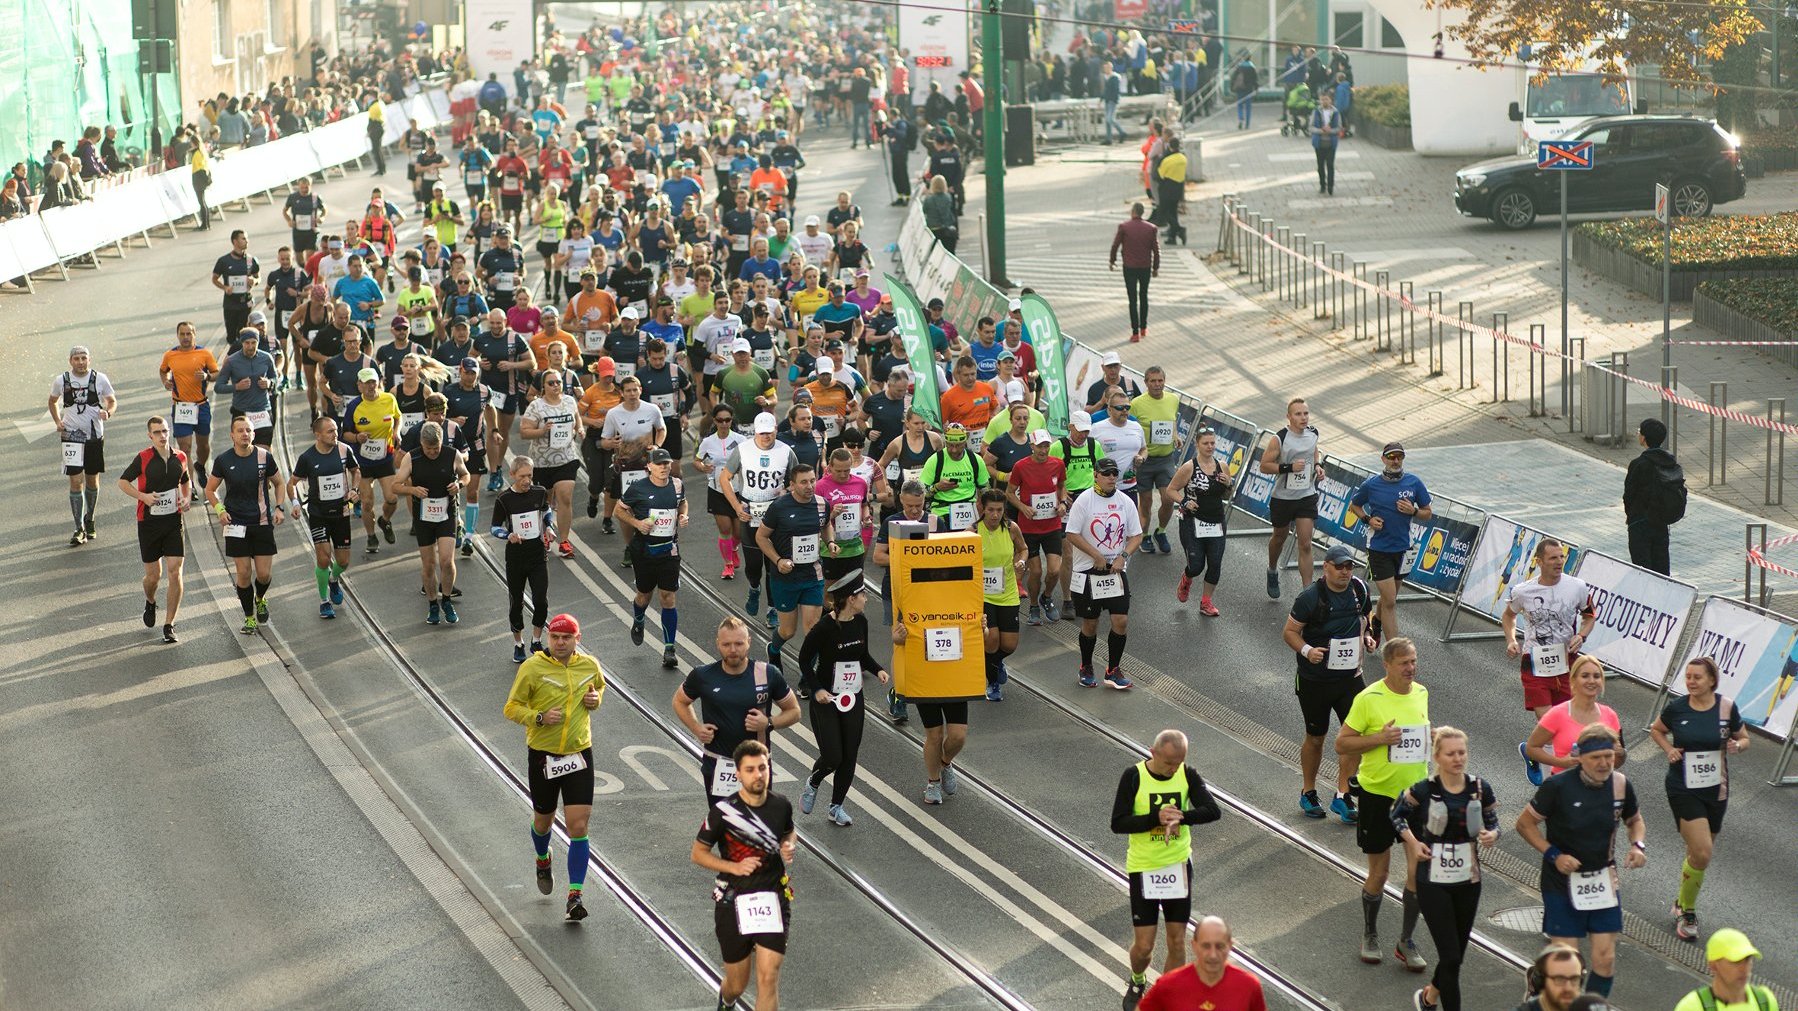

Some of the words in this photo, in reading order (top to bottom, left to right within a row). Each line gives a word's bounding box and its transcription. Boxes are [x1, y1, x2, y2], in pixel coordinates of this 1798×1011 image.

[1155, 428, 1171, 436] 6920
[365, 445, 381, 453] 7109
[746, 470, 782, 490] BGS
[323, 483, 341, 492] 5734
[427, 506, 443, 514] 3311
[1036, 502, 1054, 510] 6633
[842, 513, 855, 521] 831
[956, 511, 972, 520] 7301
[520, 521, 533, 530] 181
[654, 518, 672, 526] 6397
[797, 544, 815, 553] 2128
[903, 544, 976, 555] FOTORADAR
[1096, 579, 1115, 588] 4155
[921, 612, 977, 622] yanosik.pl
[935, 639, 952, 648] 378
[1337, 648, 1354, 658] 332
[1698, 629, 1746, 678] WAM!
[1540, 655, 1560, 665] 1831
[842, 672, 857, 681] 377
[1397, 738, 1422, 748] 2870
[551, 761, 578, 776] 5906
[1691, 763, 1716, 774] 1586
[1440, 858, 1464, 868] 800
[1149, 874, 1177, 884] 1260
[1577, 882, 1606, 896] 2866
[747, 906, 772, 917] 1143
